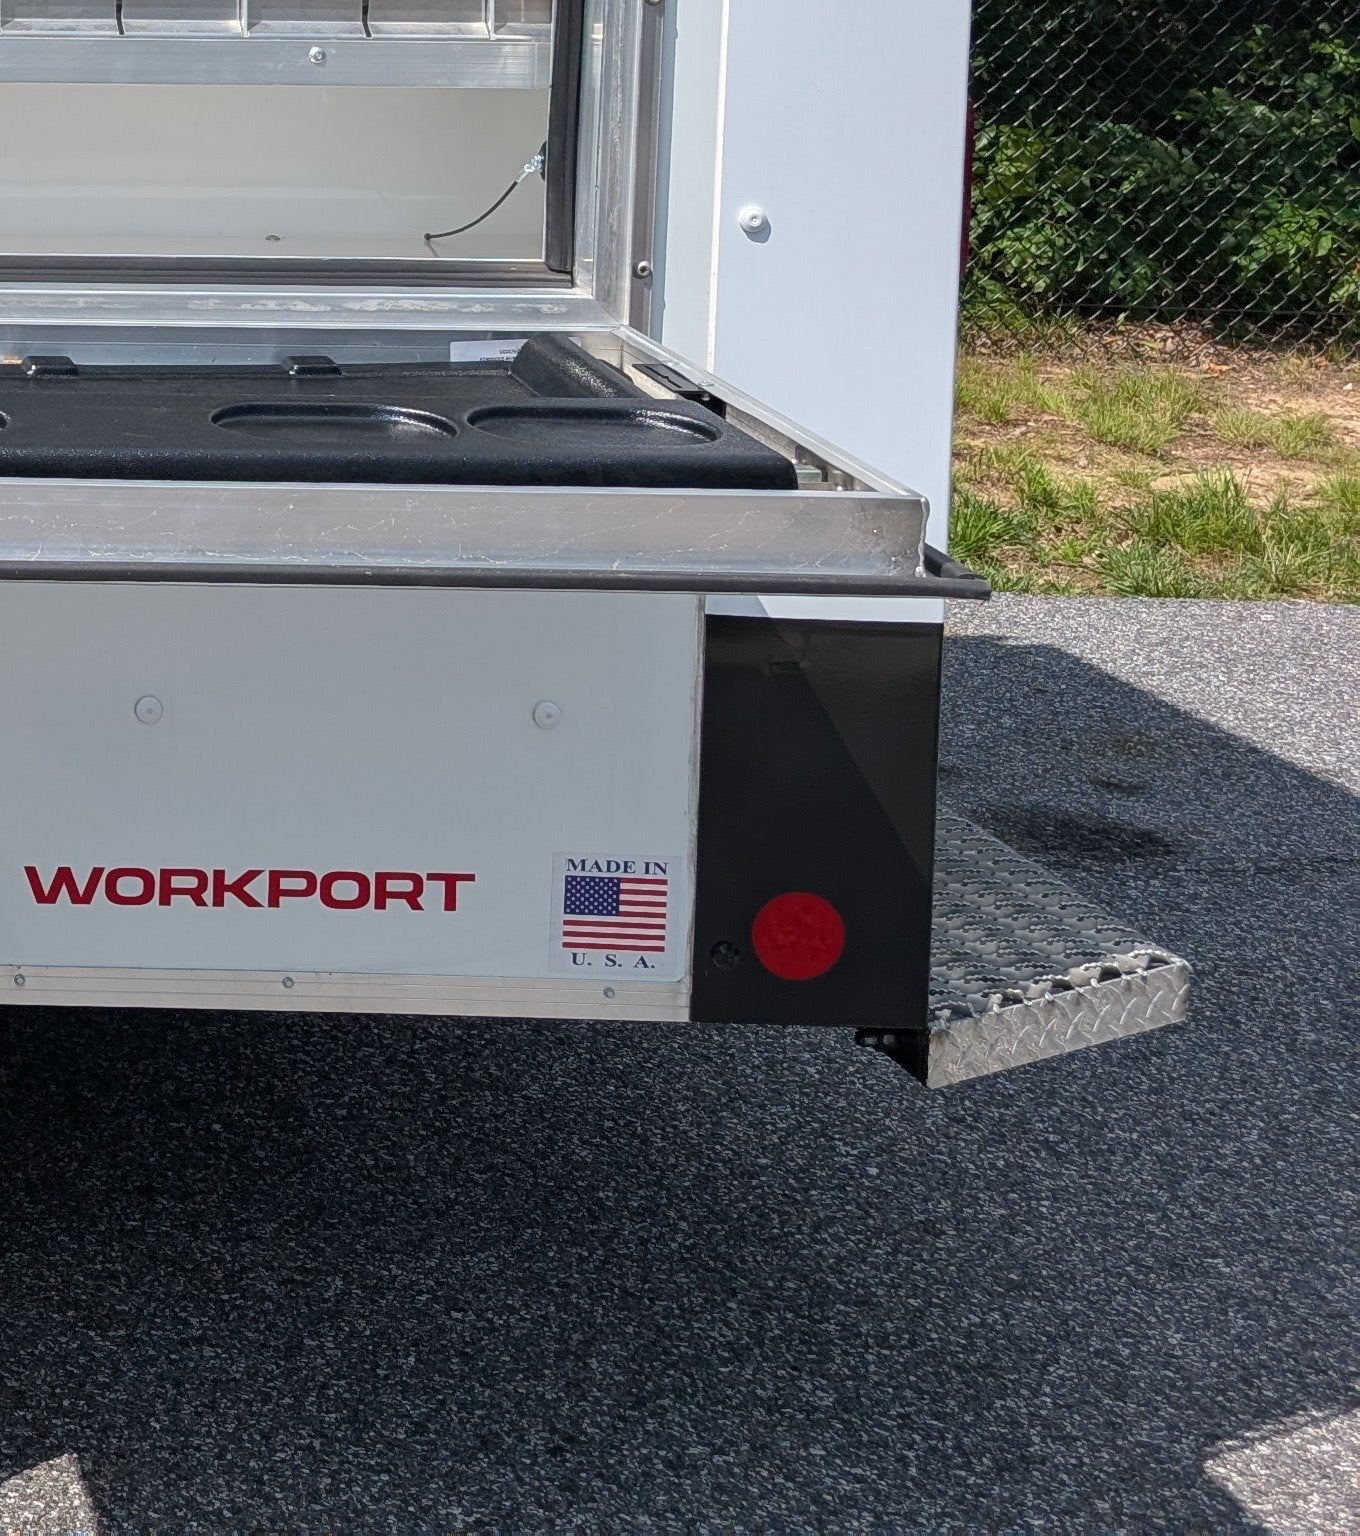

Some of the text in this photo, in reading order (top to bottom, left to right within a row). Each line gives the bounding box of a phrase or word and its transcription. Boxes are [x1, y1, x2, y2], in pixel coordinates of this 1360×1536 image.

[566, 858, 669, 875] MADE IN
[23, 865, 476, 912] WORKPORT
